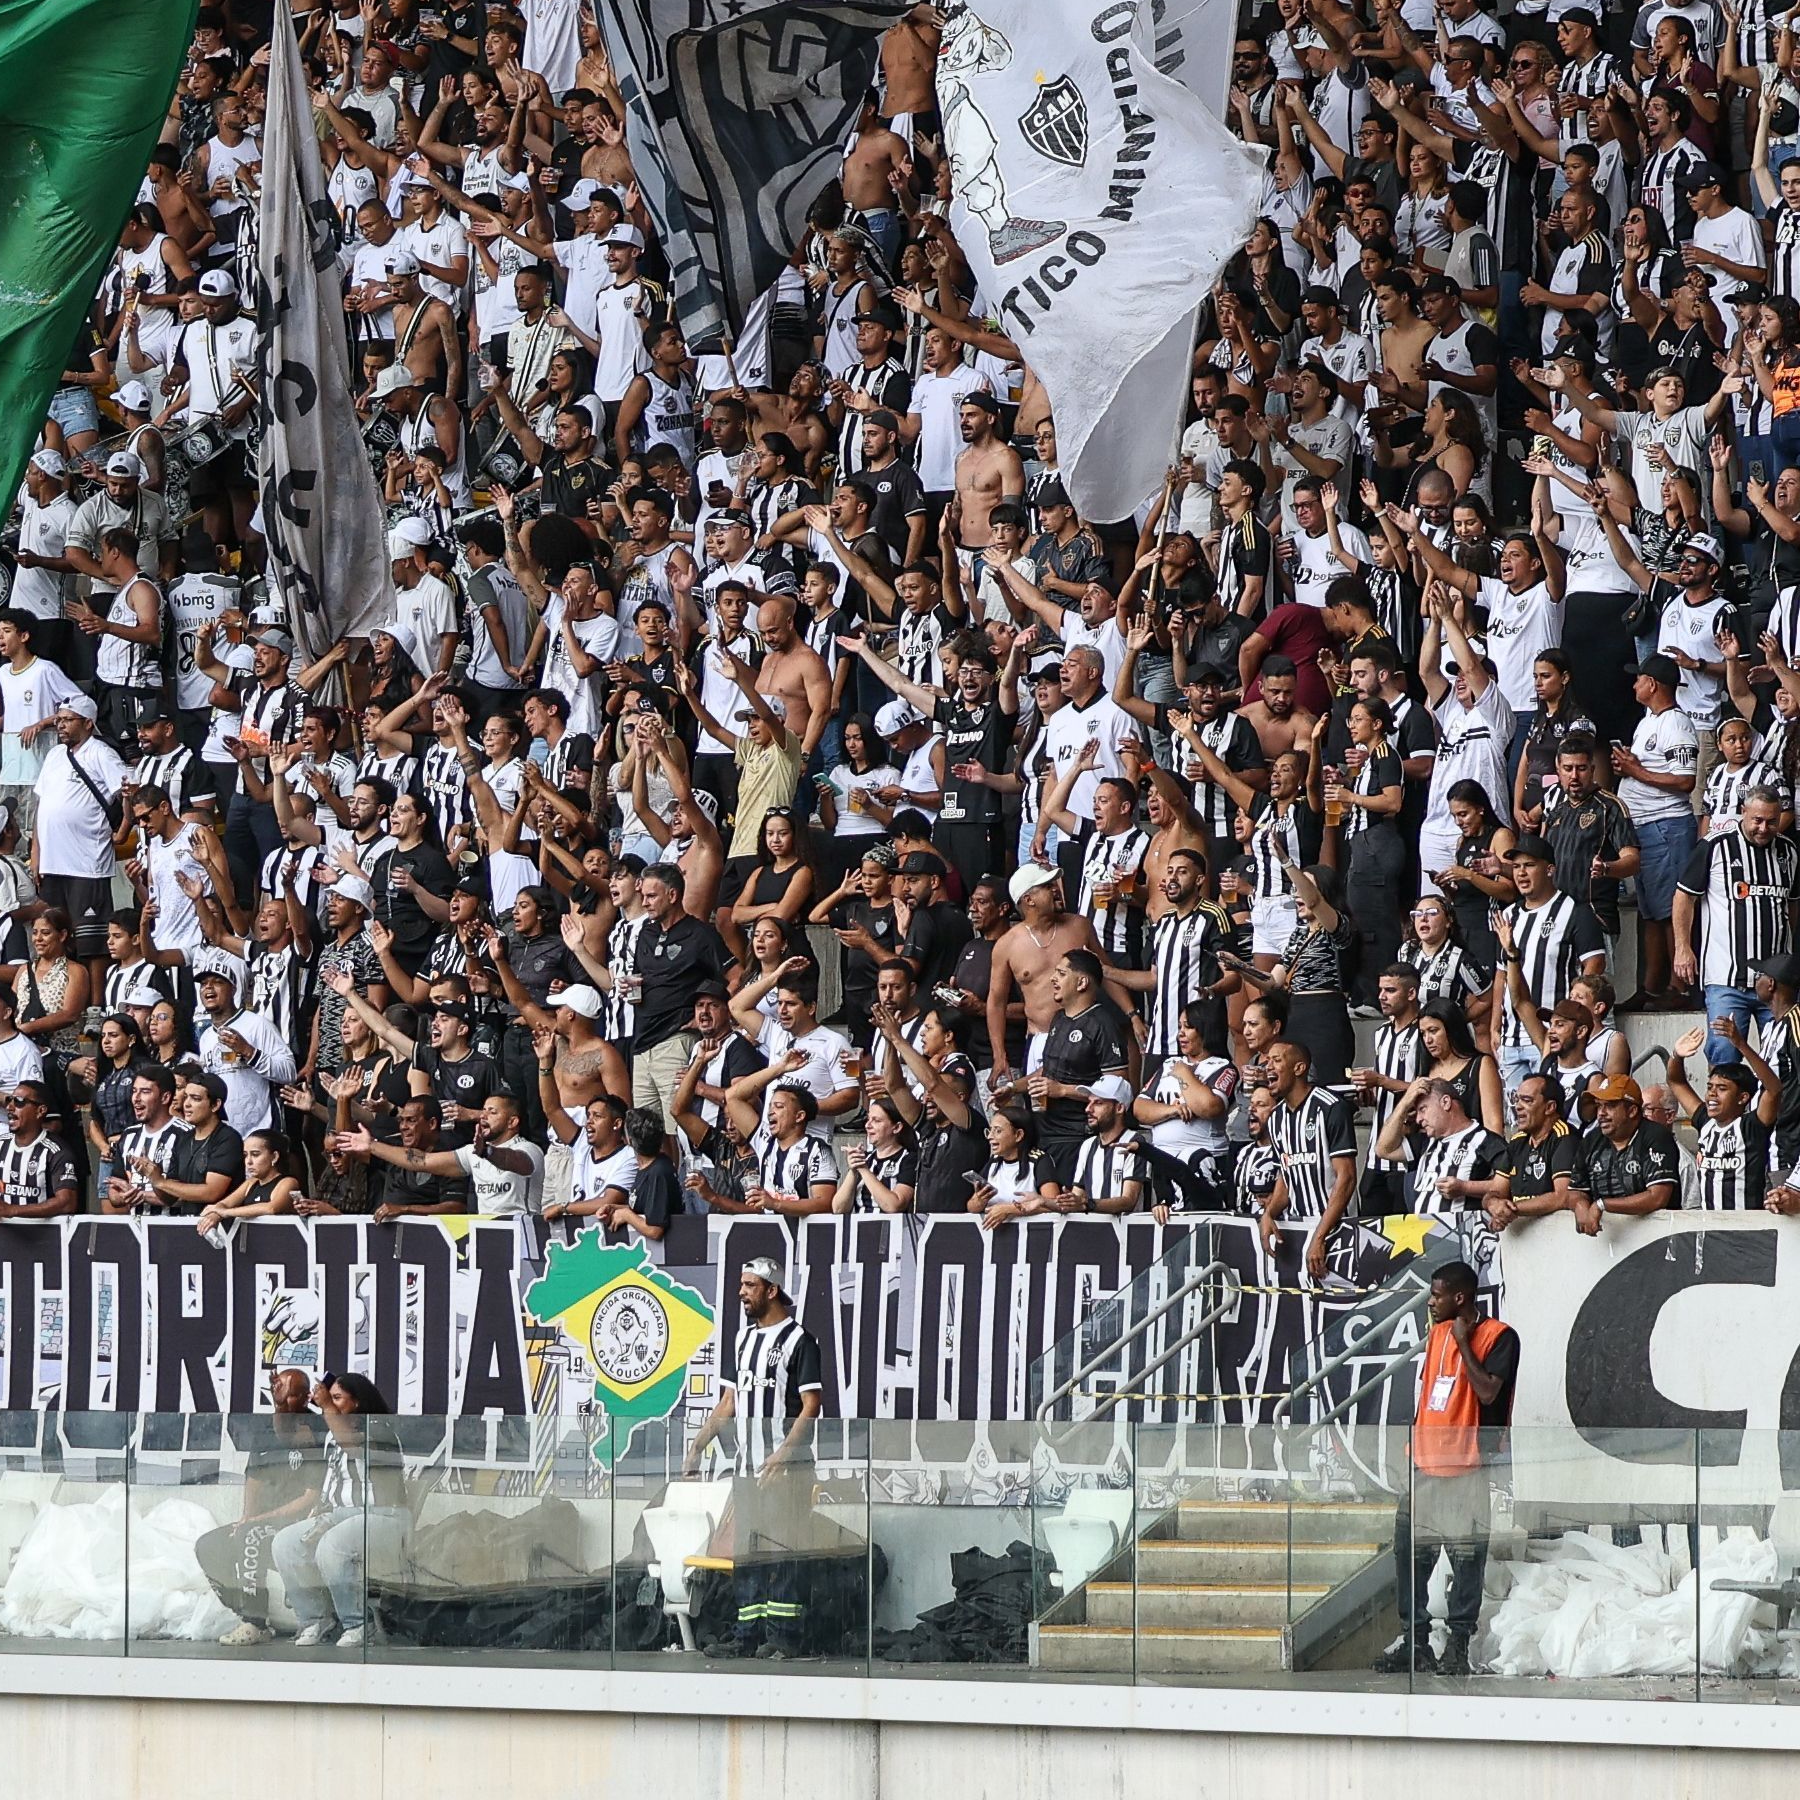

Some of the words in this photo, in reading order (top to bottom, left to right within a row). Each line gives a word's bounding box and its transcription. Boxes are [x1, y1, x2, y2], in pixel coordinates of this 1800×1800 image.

[1029, 93, 1073, 132] CAM
[1286, 468, 1311, 479] BETA
[1568, 546, 1605, 569] H2bet
[1293, 565, 1334, 586] H2bet
[1489, 616, 1523, 638] H2bet
[1057, 744, 1080, 763] H2b
[1748, 884, 1790, 898] BETANO
[1700, 1155, 1741, 1171] BETANO
[5, 1184, 40, 1197] BETANO
[477, 1182, 512, 1194] BETANO
[620, 1288, 666, 1335] ORGANIZADA
[596, 1346, 664, 1382] GALOUCURA
[737, 1369, 775, 1391] H2bet
[241, 1524, 277, 1598] LACOSTE
